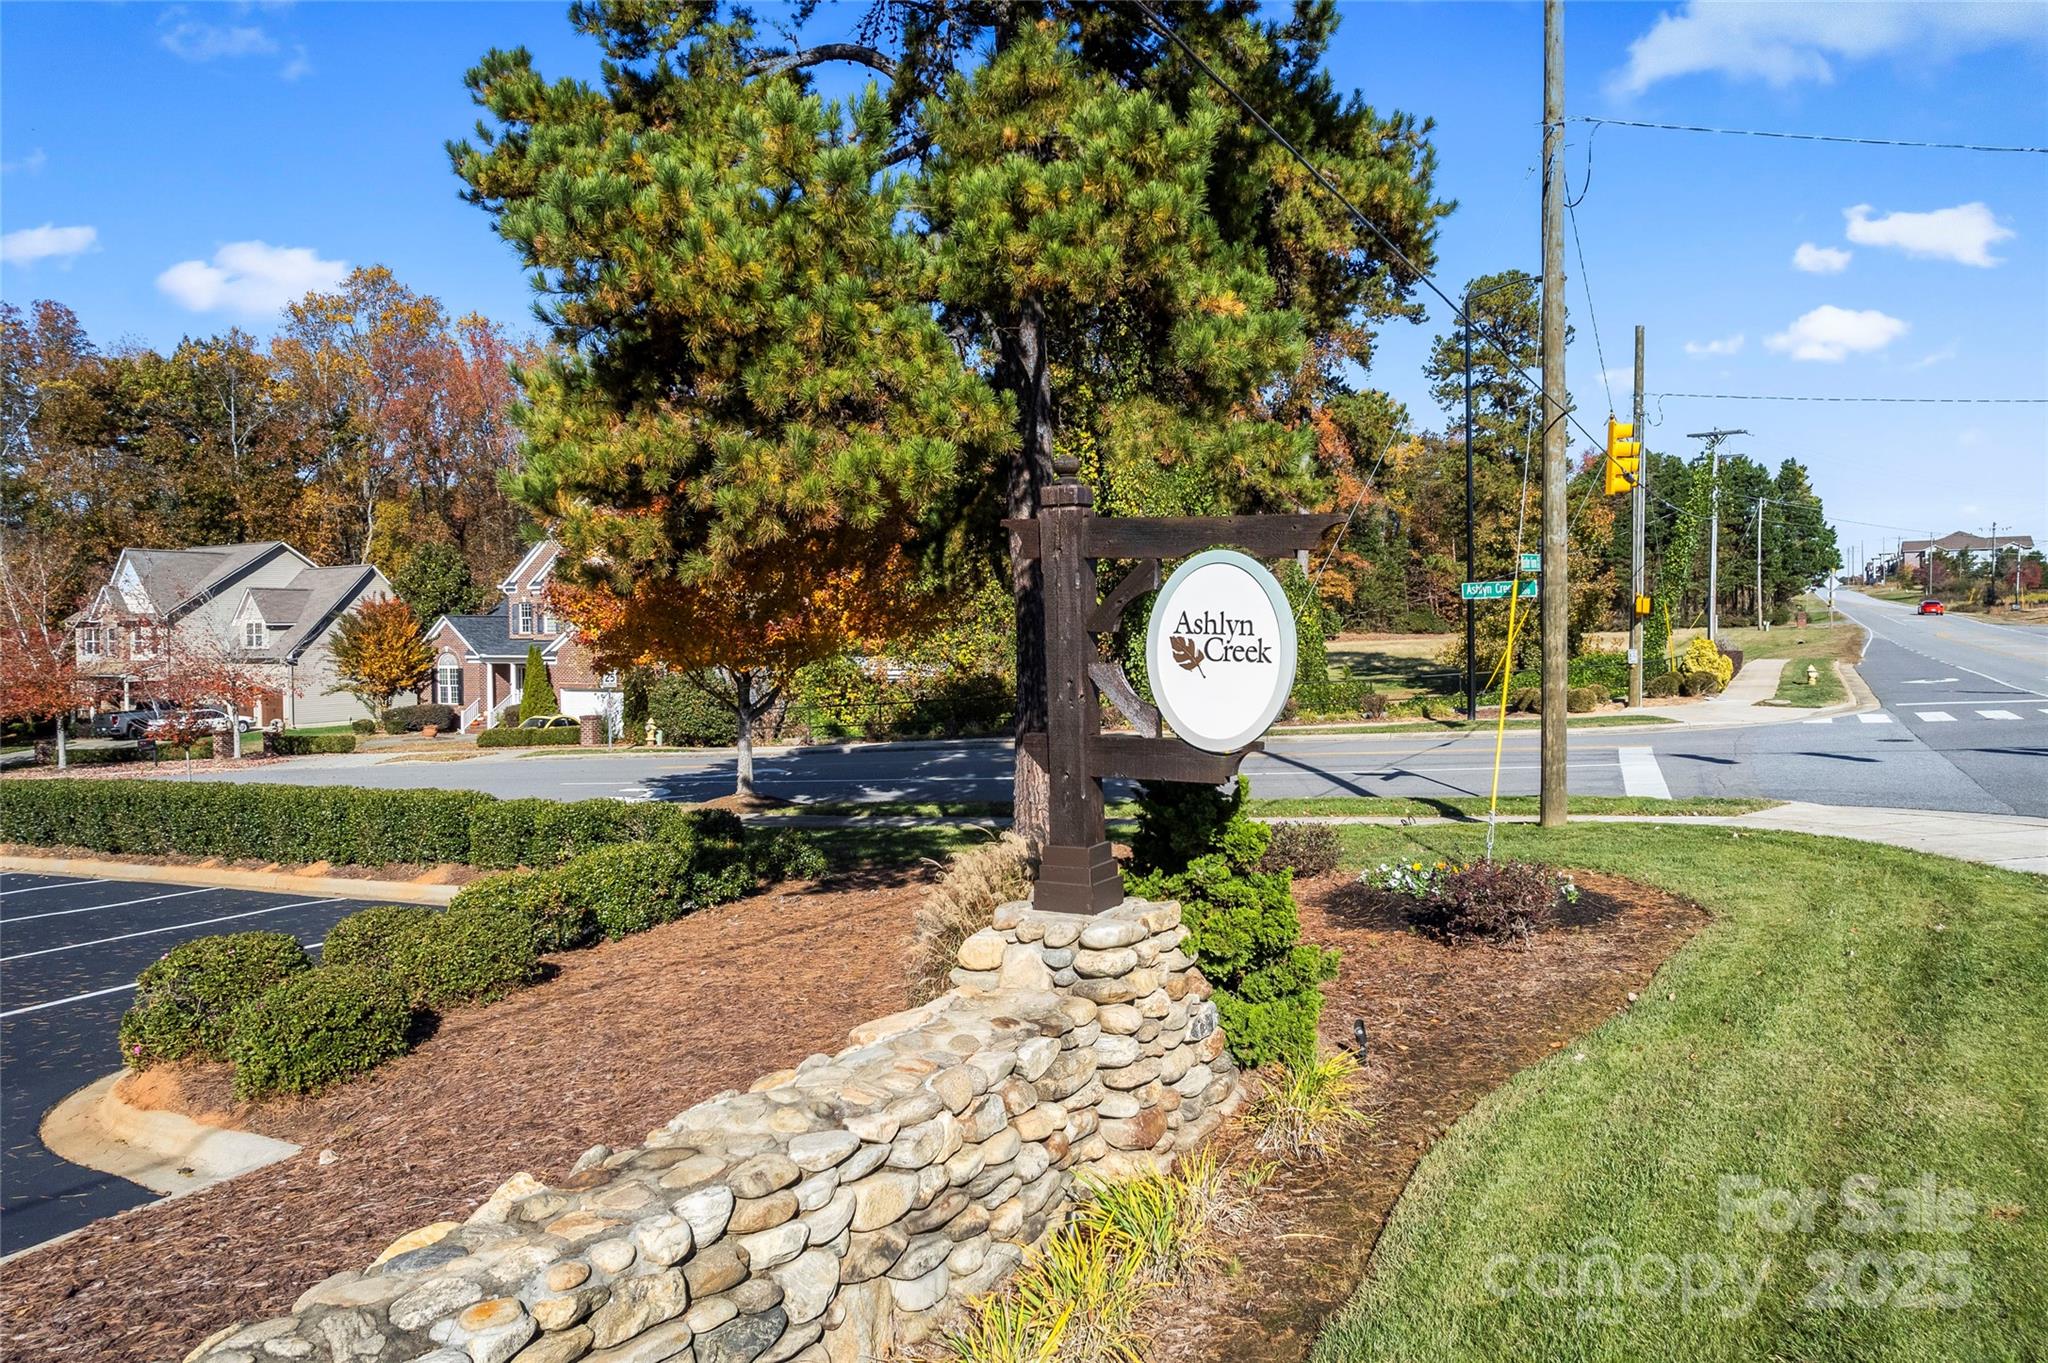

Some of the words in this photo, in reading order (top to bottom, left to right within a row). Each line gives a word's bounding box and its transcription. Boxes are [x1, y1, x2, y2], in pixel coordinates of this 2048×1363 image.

[1466, 584, 1492, 597] Ashlyn
[1495, 583, 1516, 593] Cree
[1173, 610, 1255, 644] Ashlyn
[1204, 637, 1272, 664] Creek
[605, 675, 615, 683] 25
